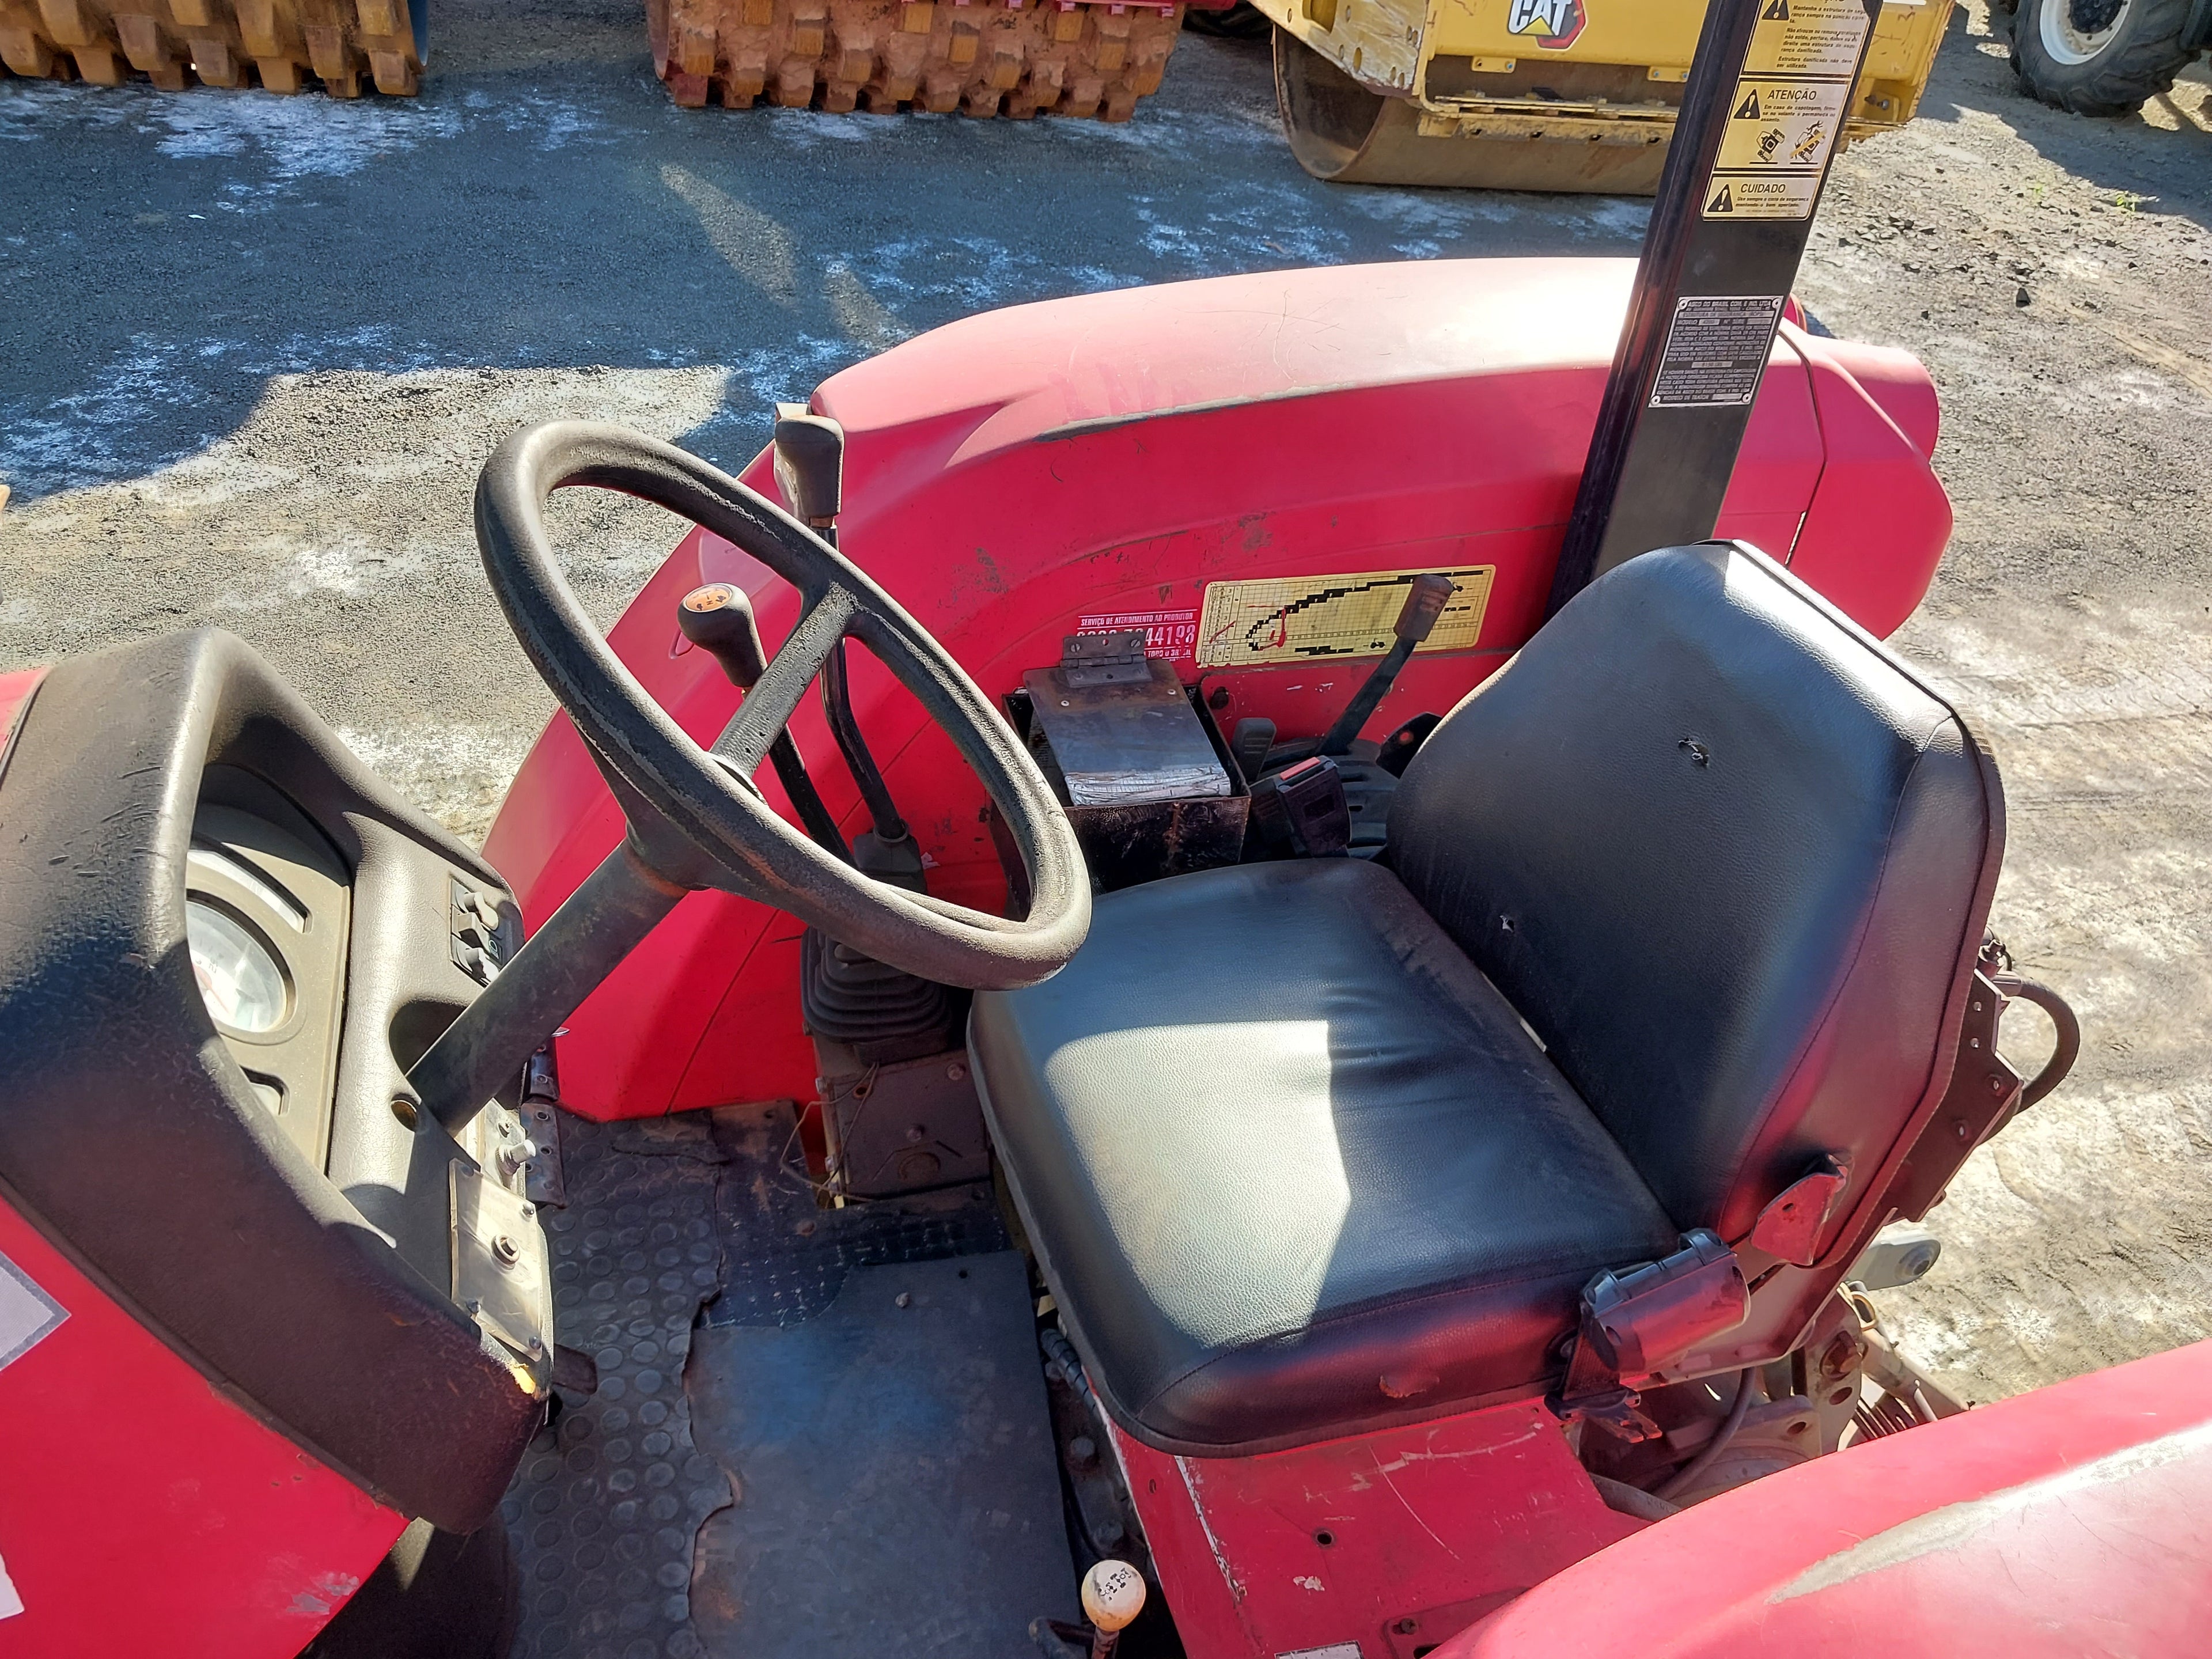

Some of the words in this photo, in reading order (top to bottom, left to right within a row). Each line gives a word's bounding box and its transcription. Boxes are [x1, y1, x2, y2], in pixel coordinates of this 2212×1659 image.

[1508, 0, 1572, 36] CAT
[1767, 88, 1817, 103] ATENÇÃO
[1740, 183, 1786, 193] CUIDADO
[1081, 618, 1105, 627] SERVIÇO
[1106, 617, 1113, 625] DE
[1114, 614, 1153, 624] ATENDIMENTO
[1154, 614, 1162, 622] AO
[1164, 612, 1193, 621] PRODUTOR
